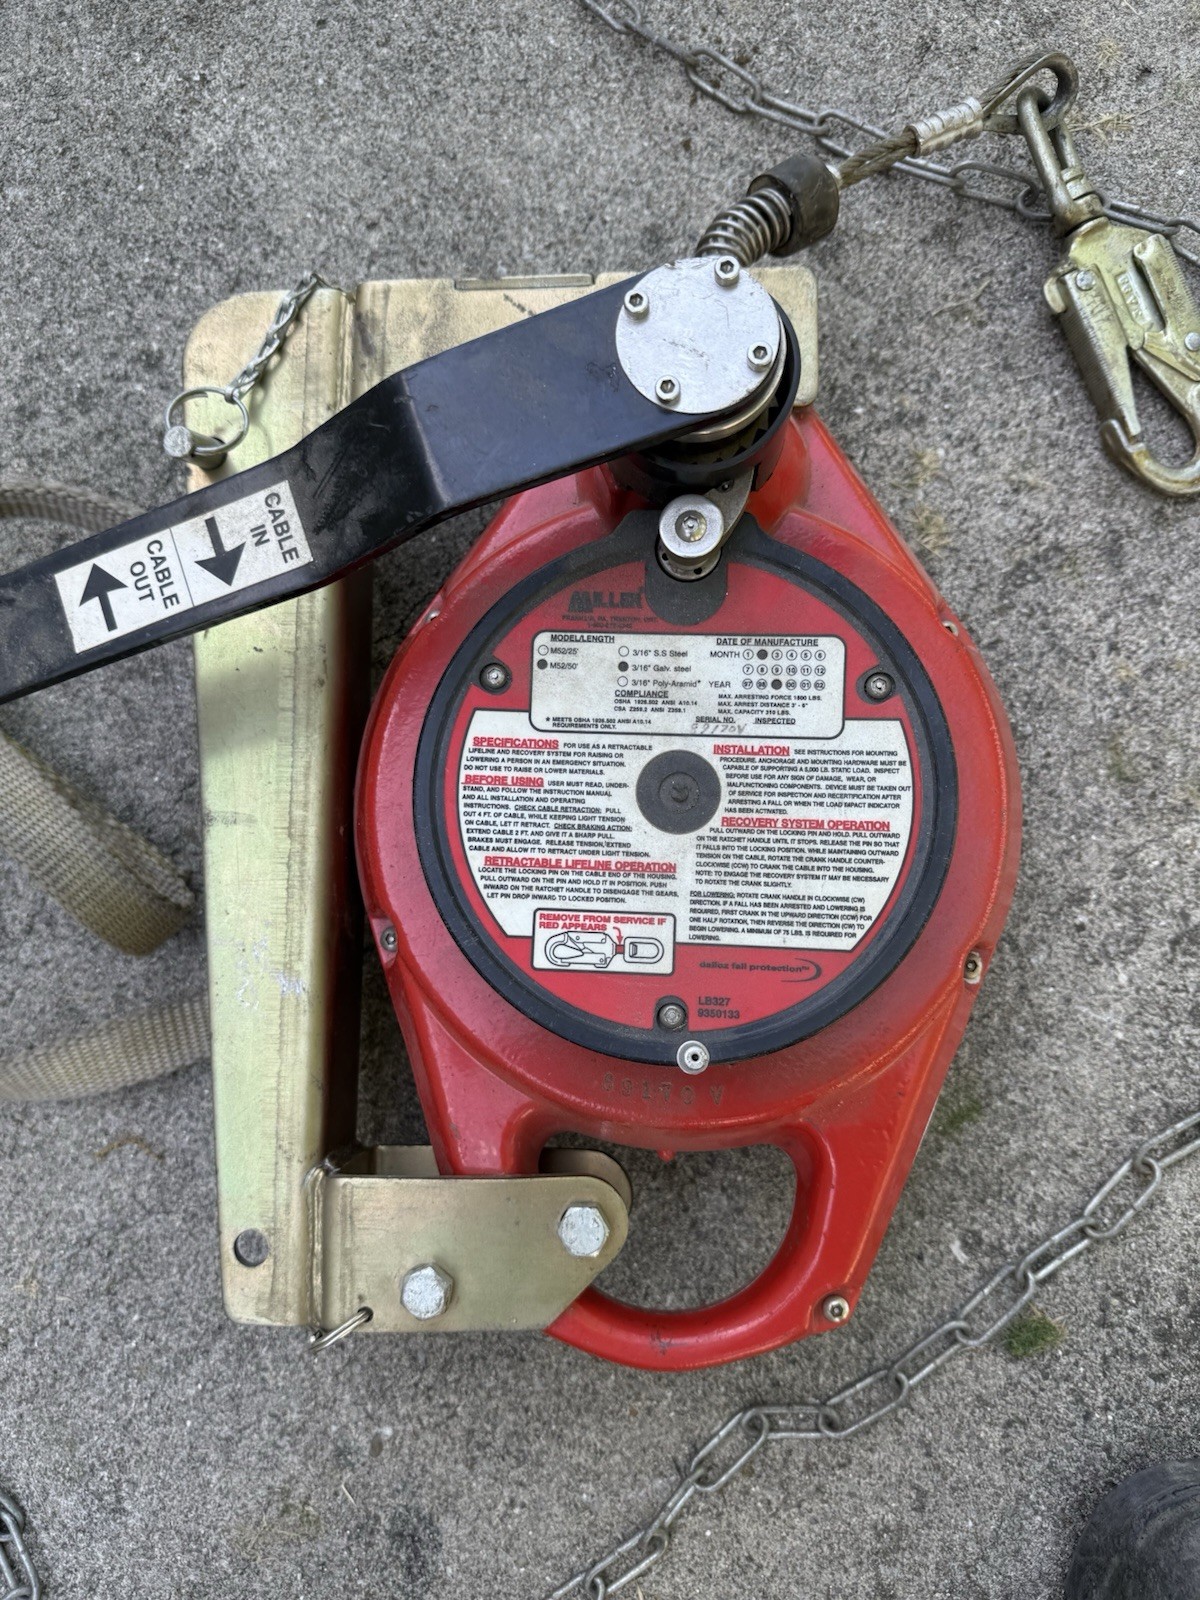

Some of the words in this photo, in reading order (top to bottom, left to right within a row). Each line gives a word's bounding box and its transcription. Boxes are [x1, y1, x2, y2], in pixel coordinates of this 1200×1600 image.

[264, 492, 299, 564] CABLE
[250, 525, 270, 547] IN
[146, 539, 180, 609] CABLE
[130, 561, 154, 602] OUT
[550, 635, 615, 643] MODEL/LENGTH
[716, 638, 738, 646] DATE
[754, 639, 818, 647] MANUFACTURE
[633, 650, 651, 658] 3/16"
[653, 650, 667, 658] S.S
[669, 650, 688, 659] Steel
[632, 665, 651, 673] 3/16"
[653, 665, 672, 673] Galv.
[674, 665, 691, 673] steel
[615, 691, 669, 699] COMPLIANCE
[473, 737, 559, 749] SPECIFICATIONS
[713, 745, 790, 756] INSTALLATION
[465, 775, 508, 786] BEFORE
[511, 777, 544, 787] USING
[721, 818, 778, 828] RECOVERY
[782, 819, 824, 829] SYSTEM
[827, 820, 890, 831] OPERATION
[484, 857, 562, 868] RETRACTABLE
[565, 860, 612, 870] LIFELINE
[615, 861, 676, 872] OPERATION
[539, 913, 580, 923] REMOVE
[583, 915, 611, 924] FROM
[613, 916, 655, 926] SERVICE
[657, 918, 666, 926] IF
[539, 922, 559, 930] RED
[561, 923, 607, 932] APPEARS
[698, 997, 730, 1006] LB327
[697, 1009, 740, 1019] 9350133
